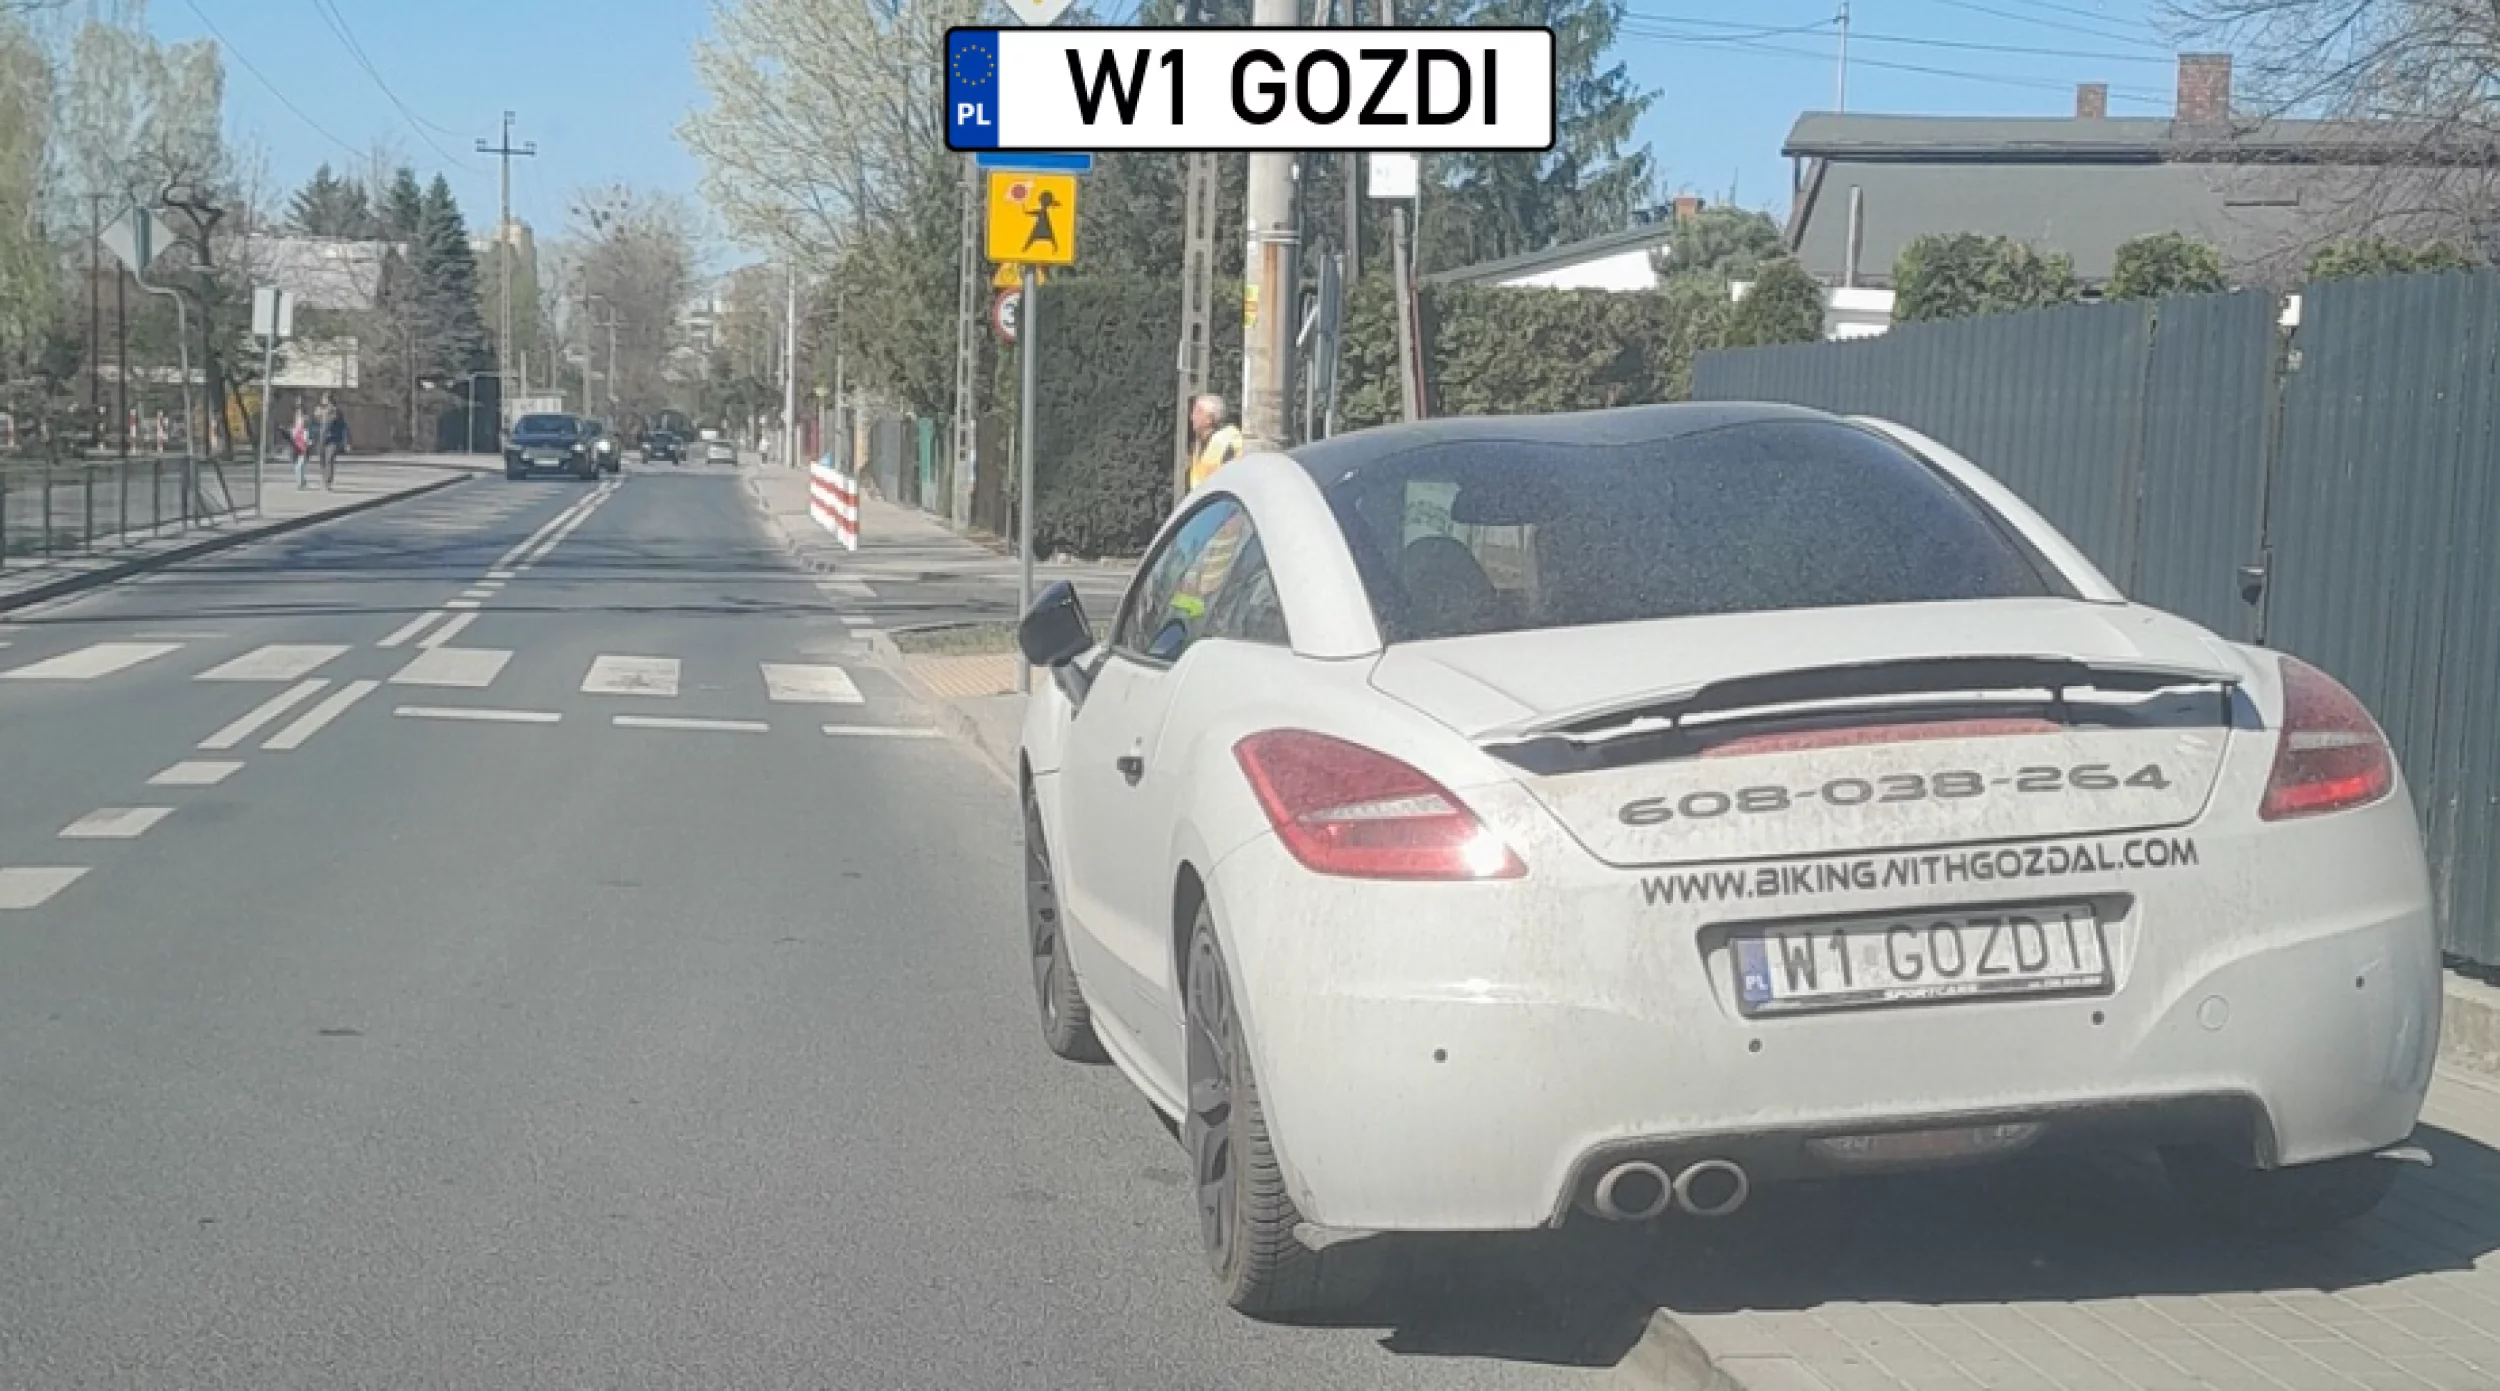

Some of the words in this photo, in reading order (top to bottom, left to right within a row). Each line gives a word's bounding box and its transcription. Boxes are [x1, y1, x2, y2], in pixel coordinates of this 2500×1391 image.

[1618, 764, 2171, 825] 608-038-264
[1745, 975, 1769, 991] PL
[1779, 928, 1853, 992] W1
[1888, 913, 2084, 980] GOZDI
